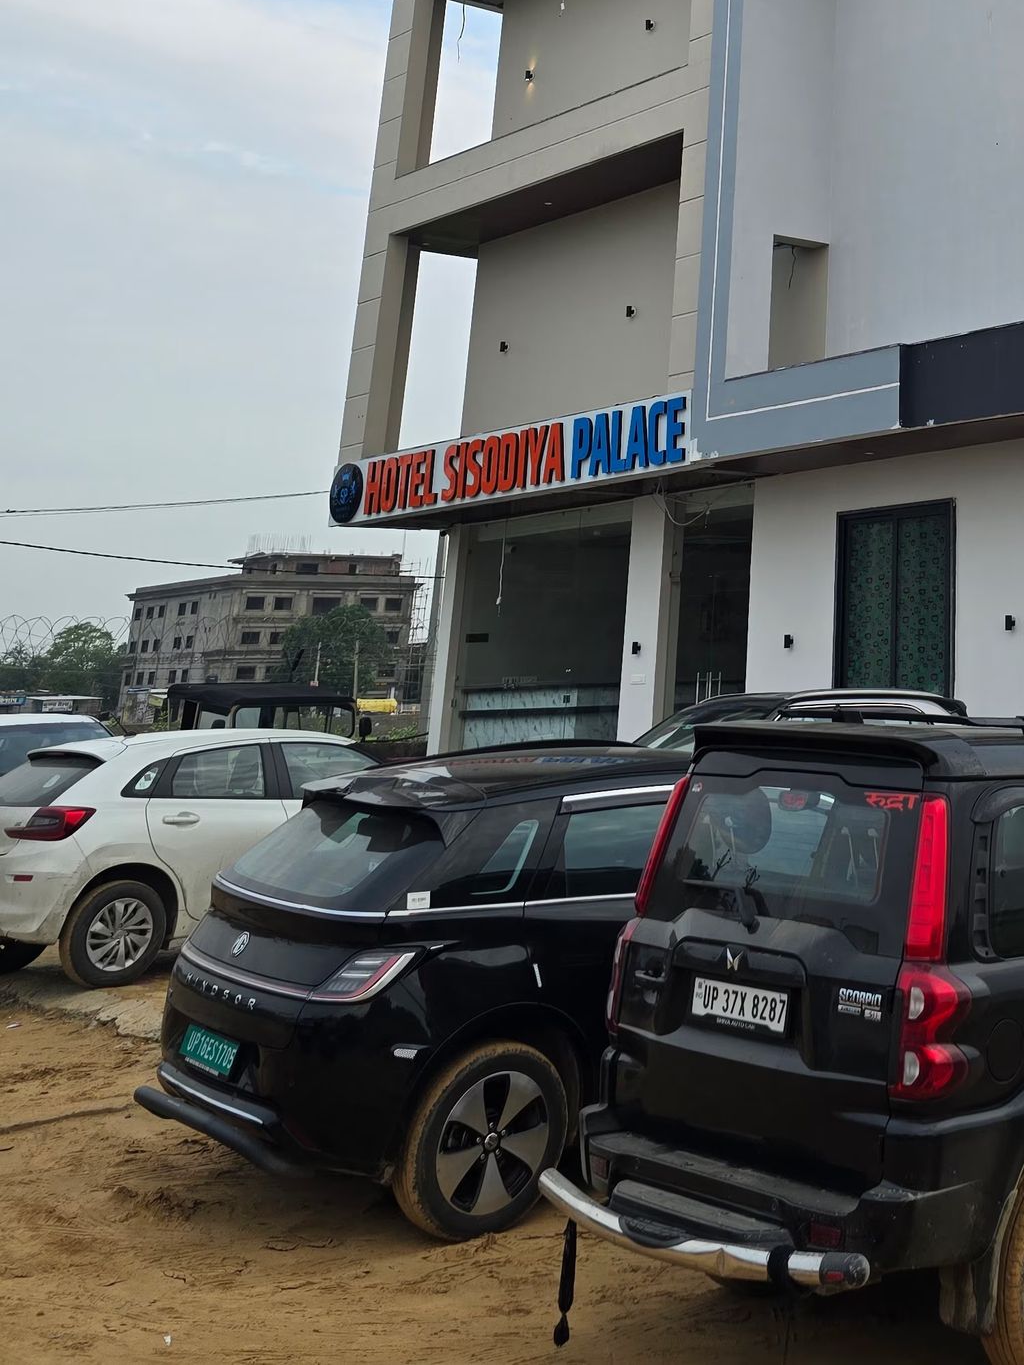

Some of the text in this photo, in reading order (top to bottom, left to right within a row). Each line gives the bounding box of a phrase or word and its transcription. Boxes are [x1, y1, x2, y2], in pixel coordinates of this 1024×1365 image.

[363, 396, 687, 515] HOTEL SISODIYA PALACE
[702, 984, 786, 1024] UP 37X 8287
[838, 988, 882, 1007] SCORPIO
[187, 1030, 237, 1069] UP16ES1705
